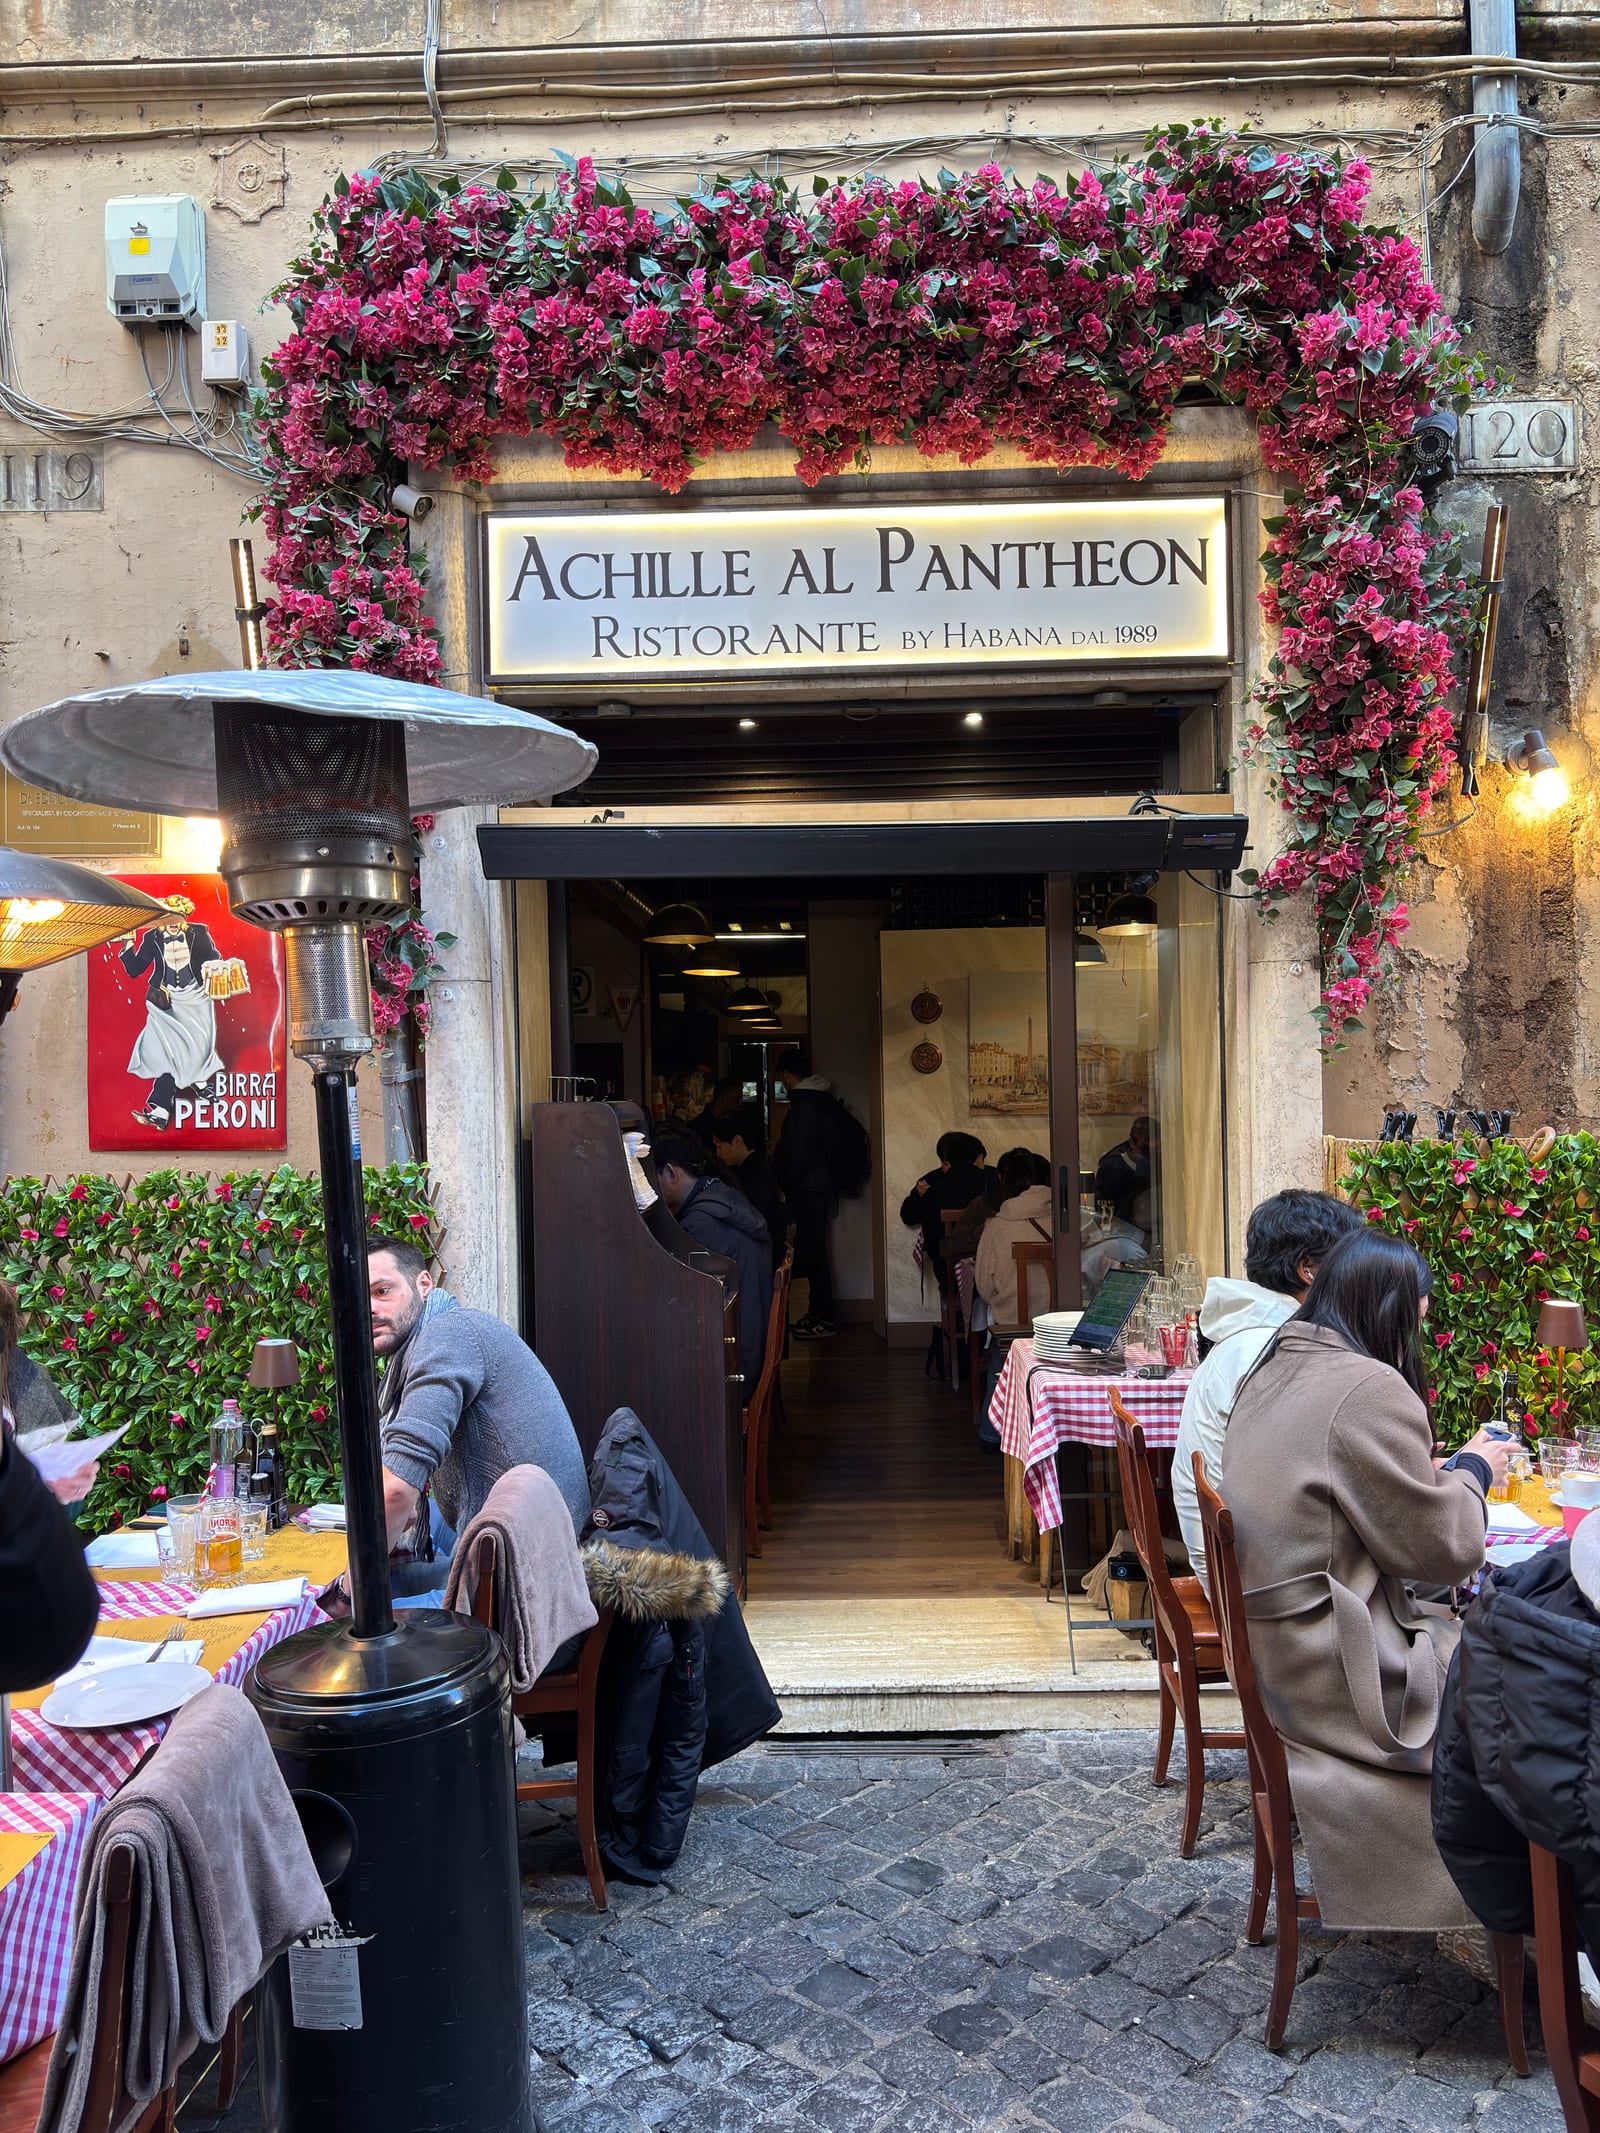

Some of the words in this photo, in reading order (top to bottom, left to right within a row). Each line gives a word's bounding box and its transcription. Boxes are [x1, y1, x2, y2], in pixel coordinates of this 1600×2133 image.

[1465, 409, 1567, 461] 120
[3, 453, 94, 501] 119
[506, 535, 756, 602] ACHILLE
[778, 547, 854, 596] AL
[876, 526, 1210, 593] PANTHEON
[591, 615, 881, 659] RISTORANTE
[901, 630, 935, 650] BY
[943, 622, 1063, 649] HABANA
[1071, 630, 1110, 645] DAL
[1114, 624, 1158, 644] 1989
[216, 1072, 276, 1097] BIRRA
[175, 1098, 277, 1129] PERONI
